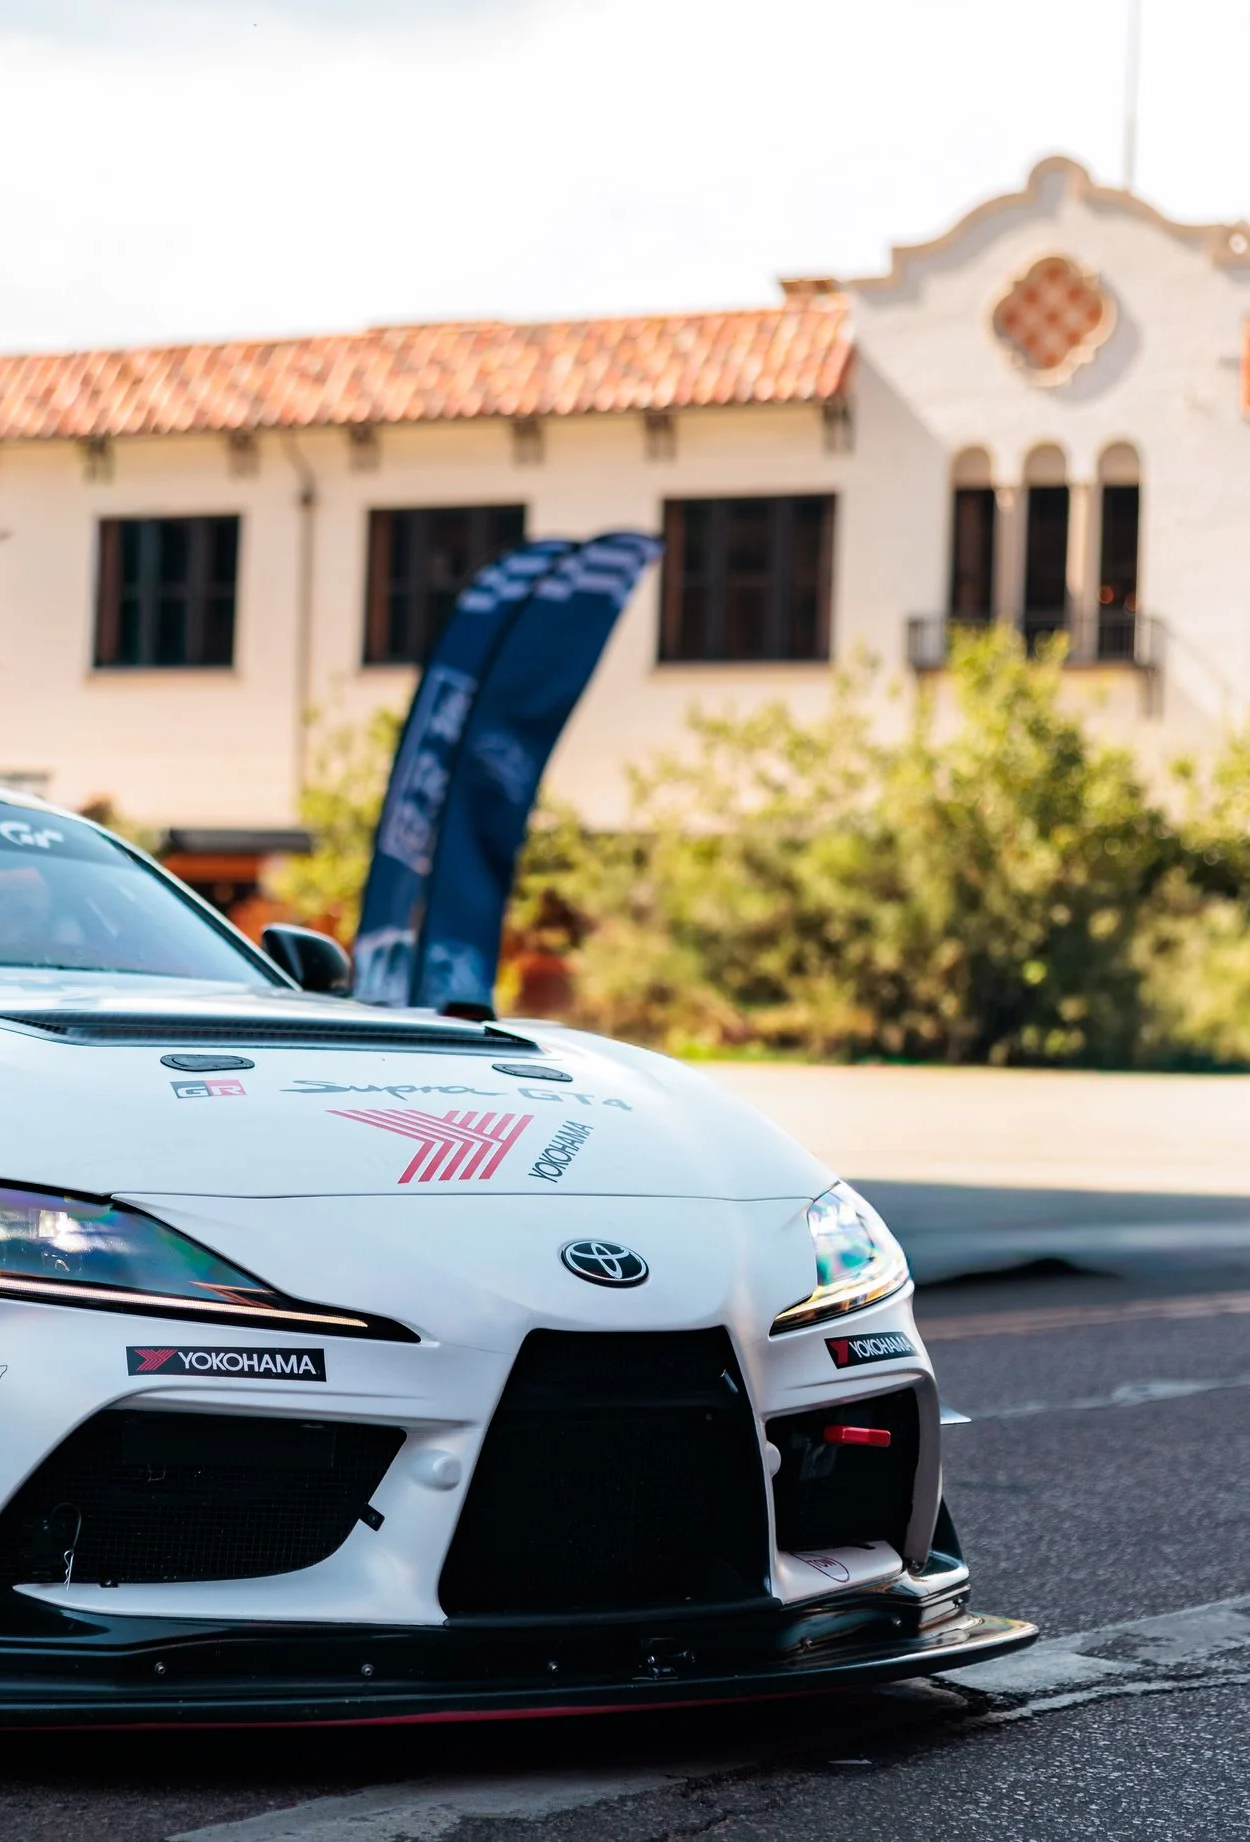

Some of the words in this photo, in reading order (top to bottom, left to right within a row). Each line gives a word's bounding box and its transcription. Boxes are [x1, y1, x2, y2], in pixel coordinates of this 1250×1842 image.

[279, 1079, 507, 1101] Supra
[517, 1087, 634, 1111] GT4
[528, 1119, 594, 1184] YOKOHAMA
[848, 1335, 916, 1359] YOKOHAMA
[178, 1351, 317, 1377] YOKOHAMA
